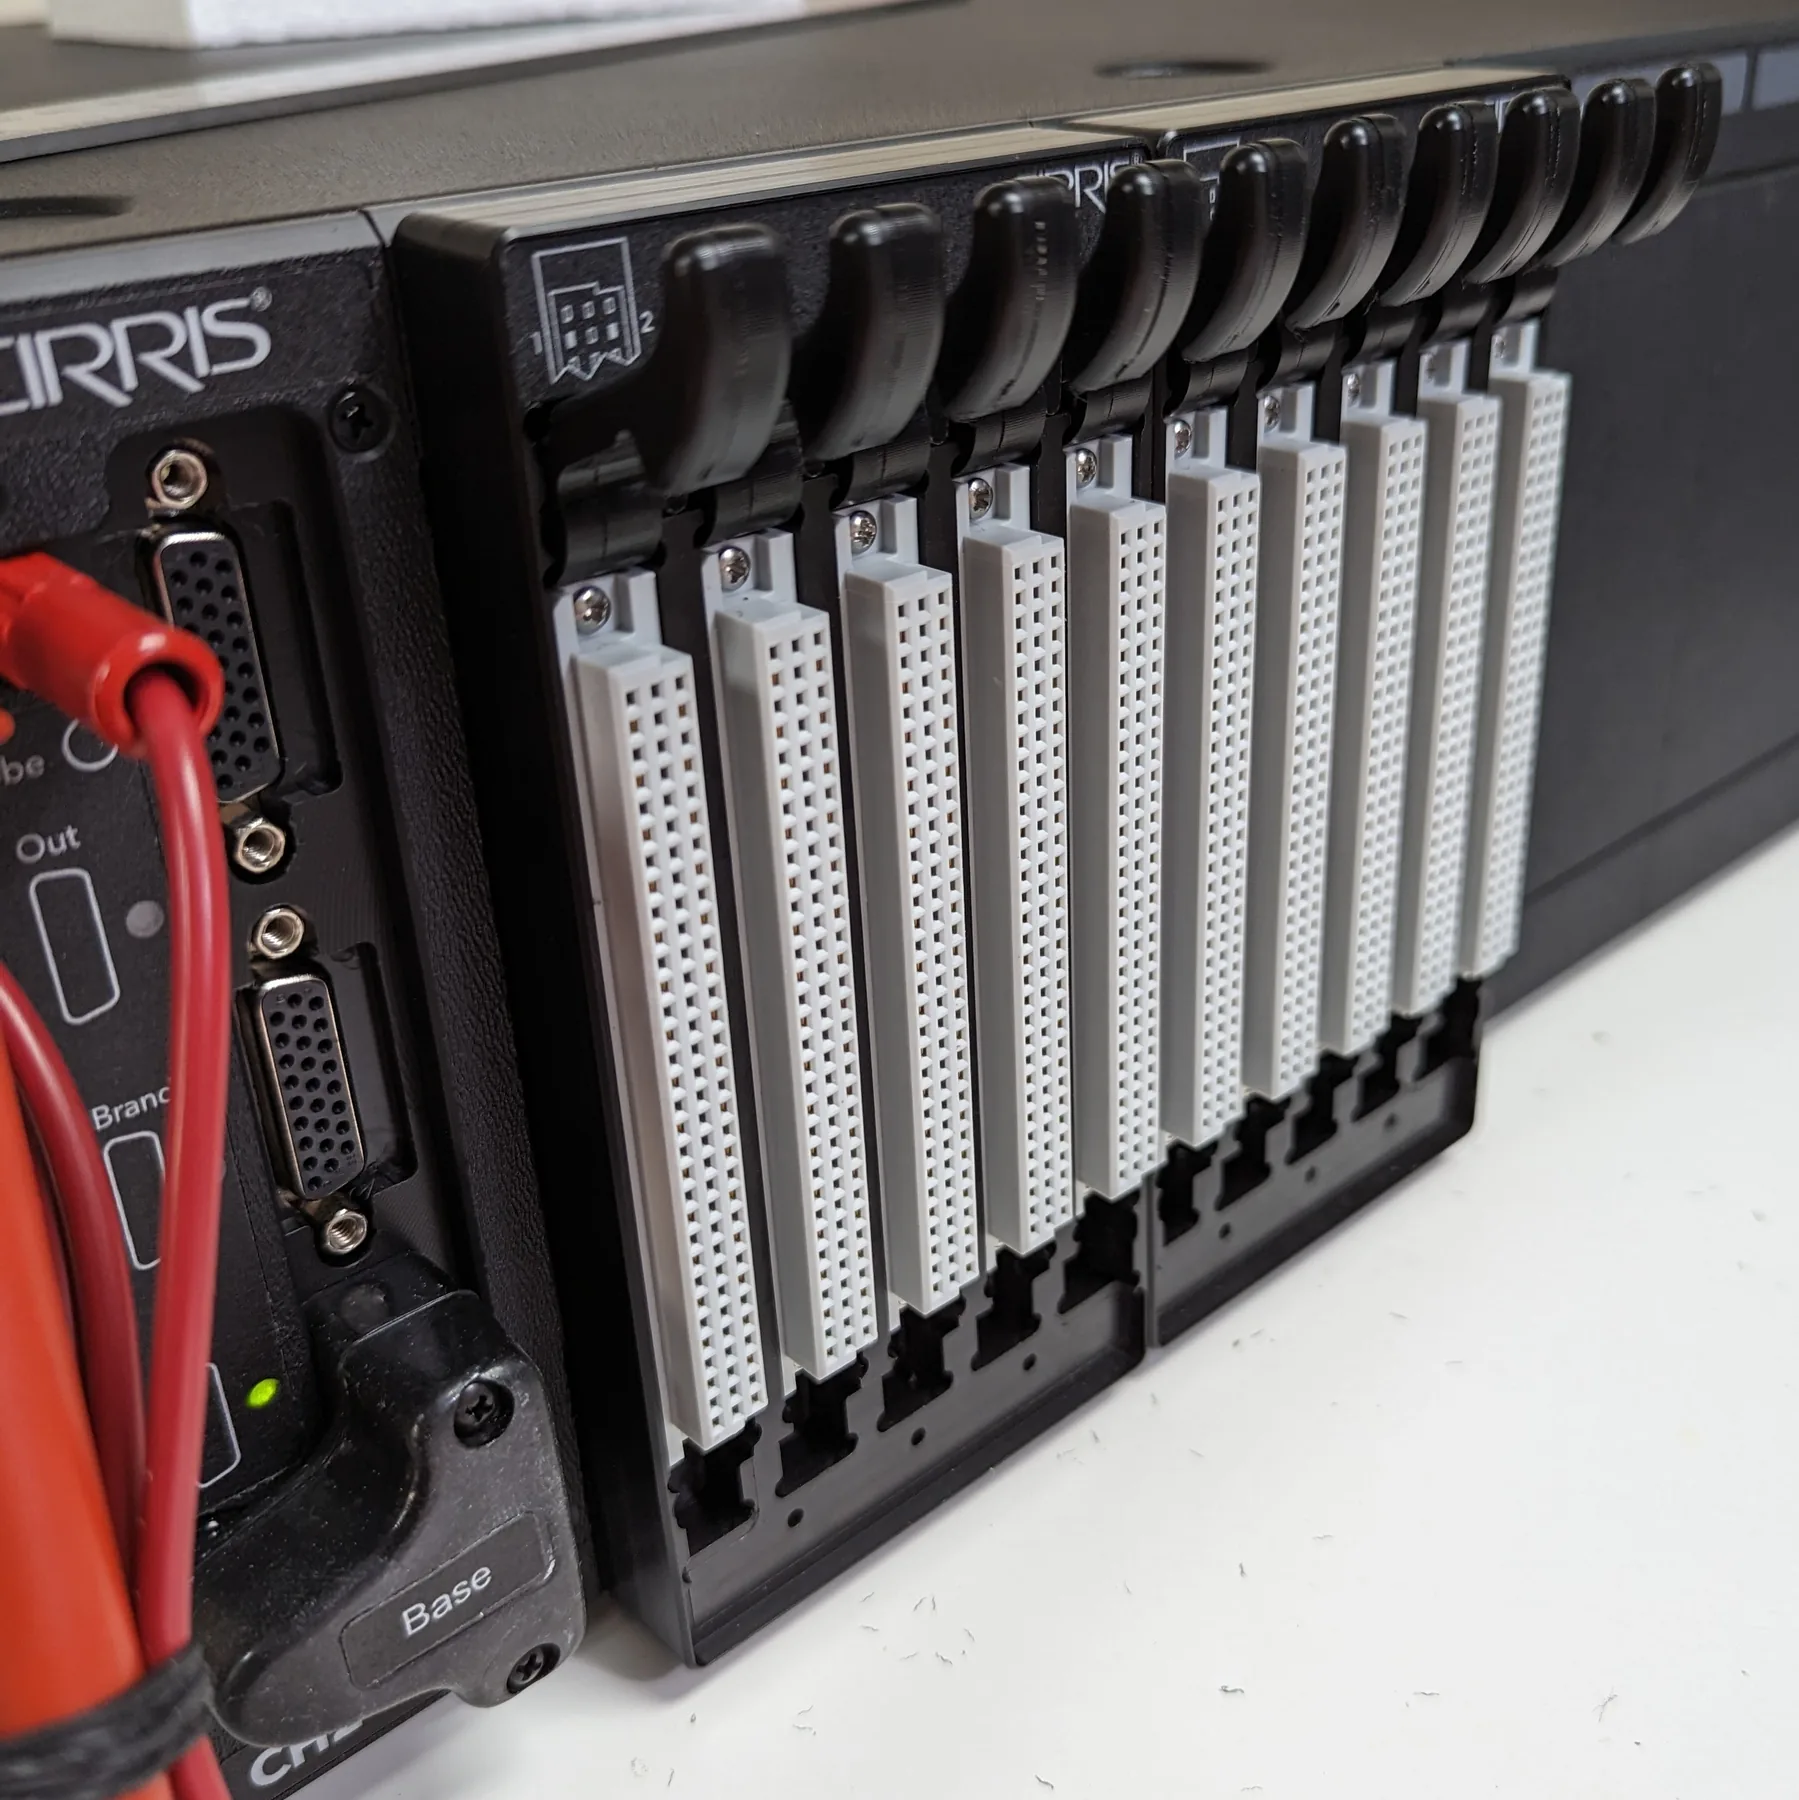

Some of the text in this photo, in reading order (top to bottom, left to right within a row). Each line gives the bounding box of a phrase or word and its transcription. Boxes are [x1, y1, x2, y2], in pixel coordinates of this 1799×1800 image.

[639, 310, 655, 334] 2
[16, 824, 82, 864] Out
[91, 1085, 171, 1132] Branc
[402, 1566, 492, 1636] Base
[250, 1718, 363, 1786] CH
